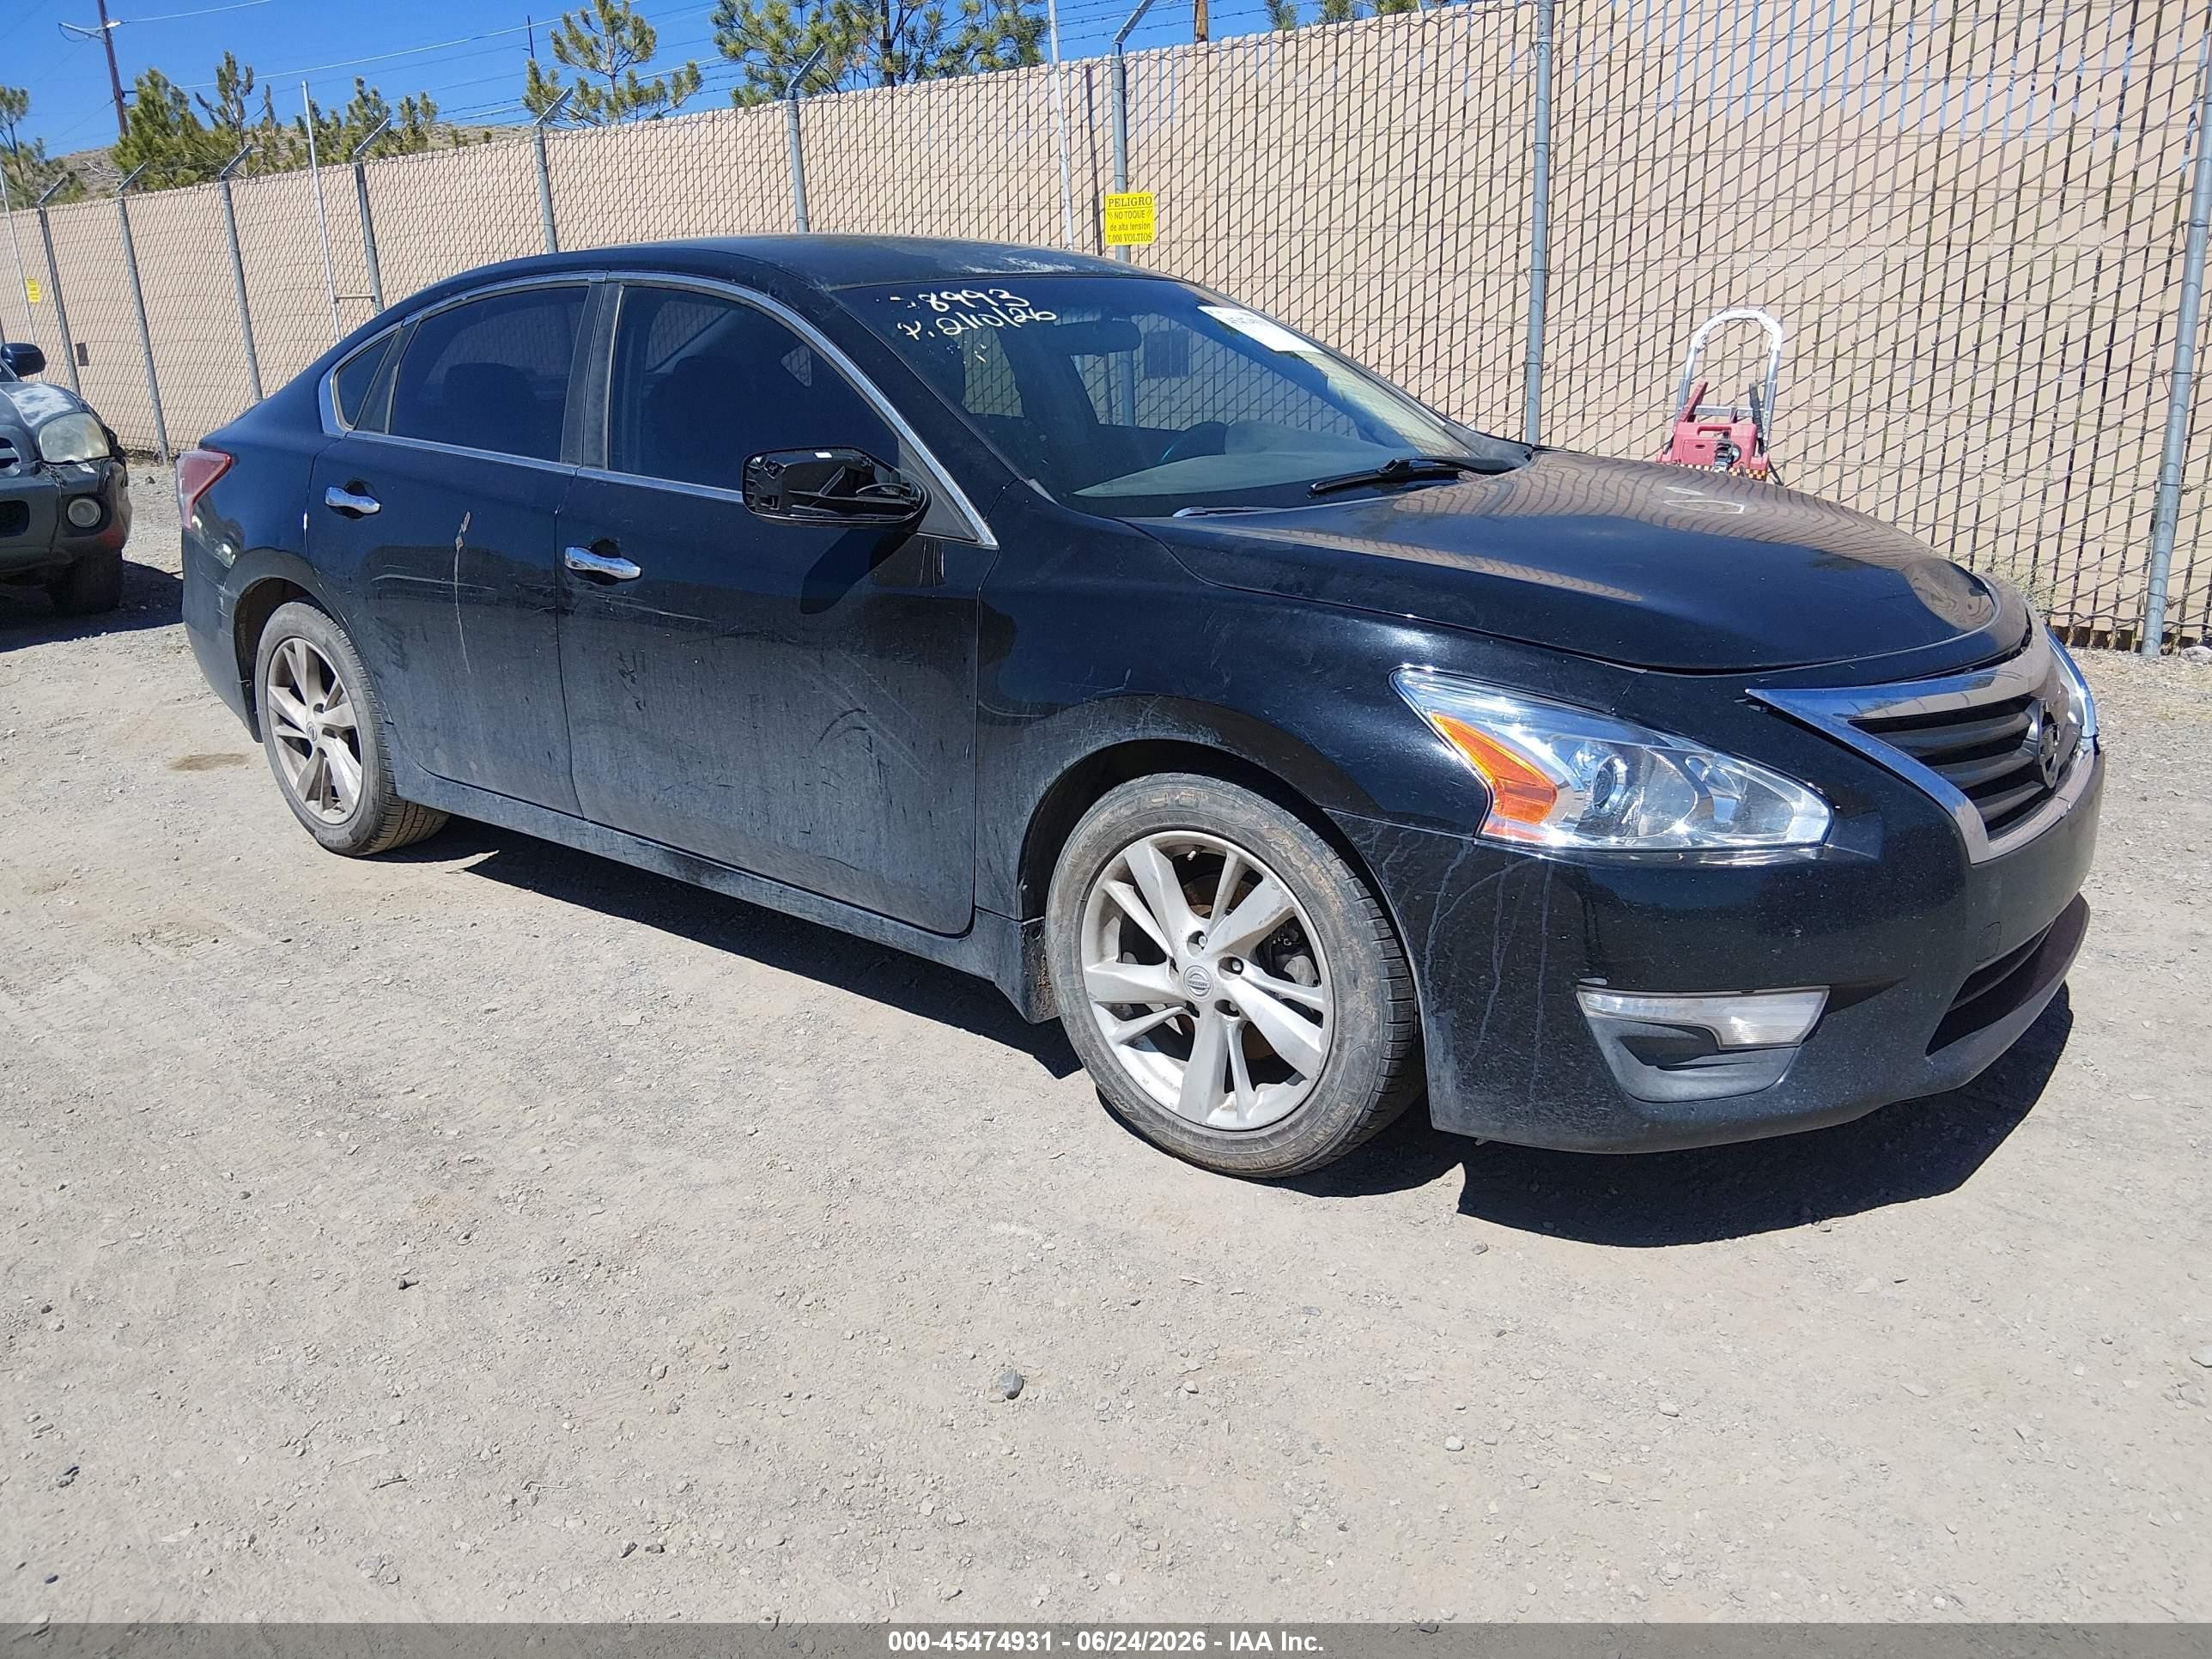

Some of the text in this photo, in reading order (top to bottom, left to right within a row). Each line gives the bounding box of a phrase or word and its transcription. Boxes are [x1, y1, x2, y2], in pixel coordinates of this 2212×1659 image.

[1108, 196, 1152, 208] PELIGRO
[1114, 210, 1146, 220] NO TOQUE
[1123, 233, 1152, 242] VOLTIOS
